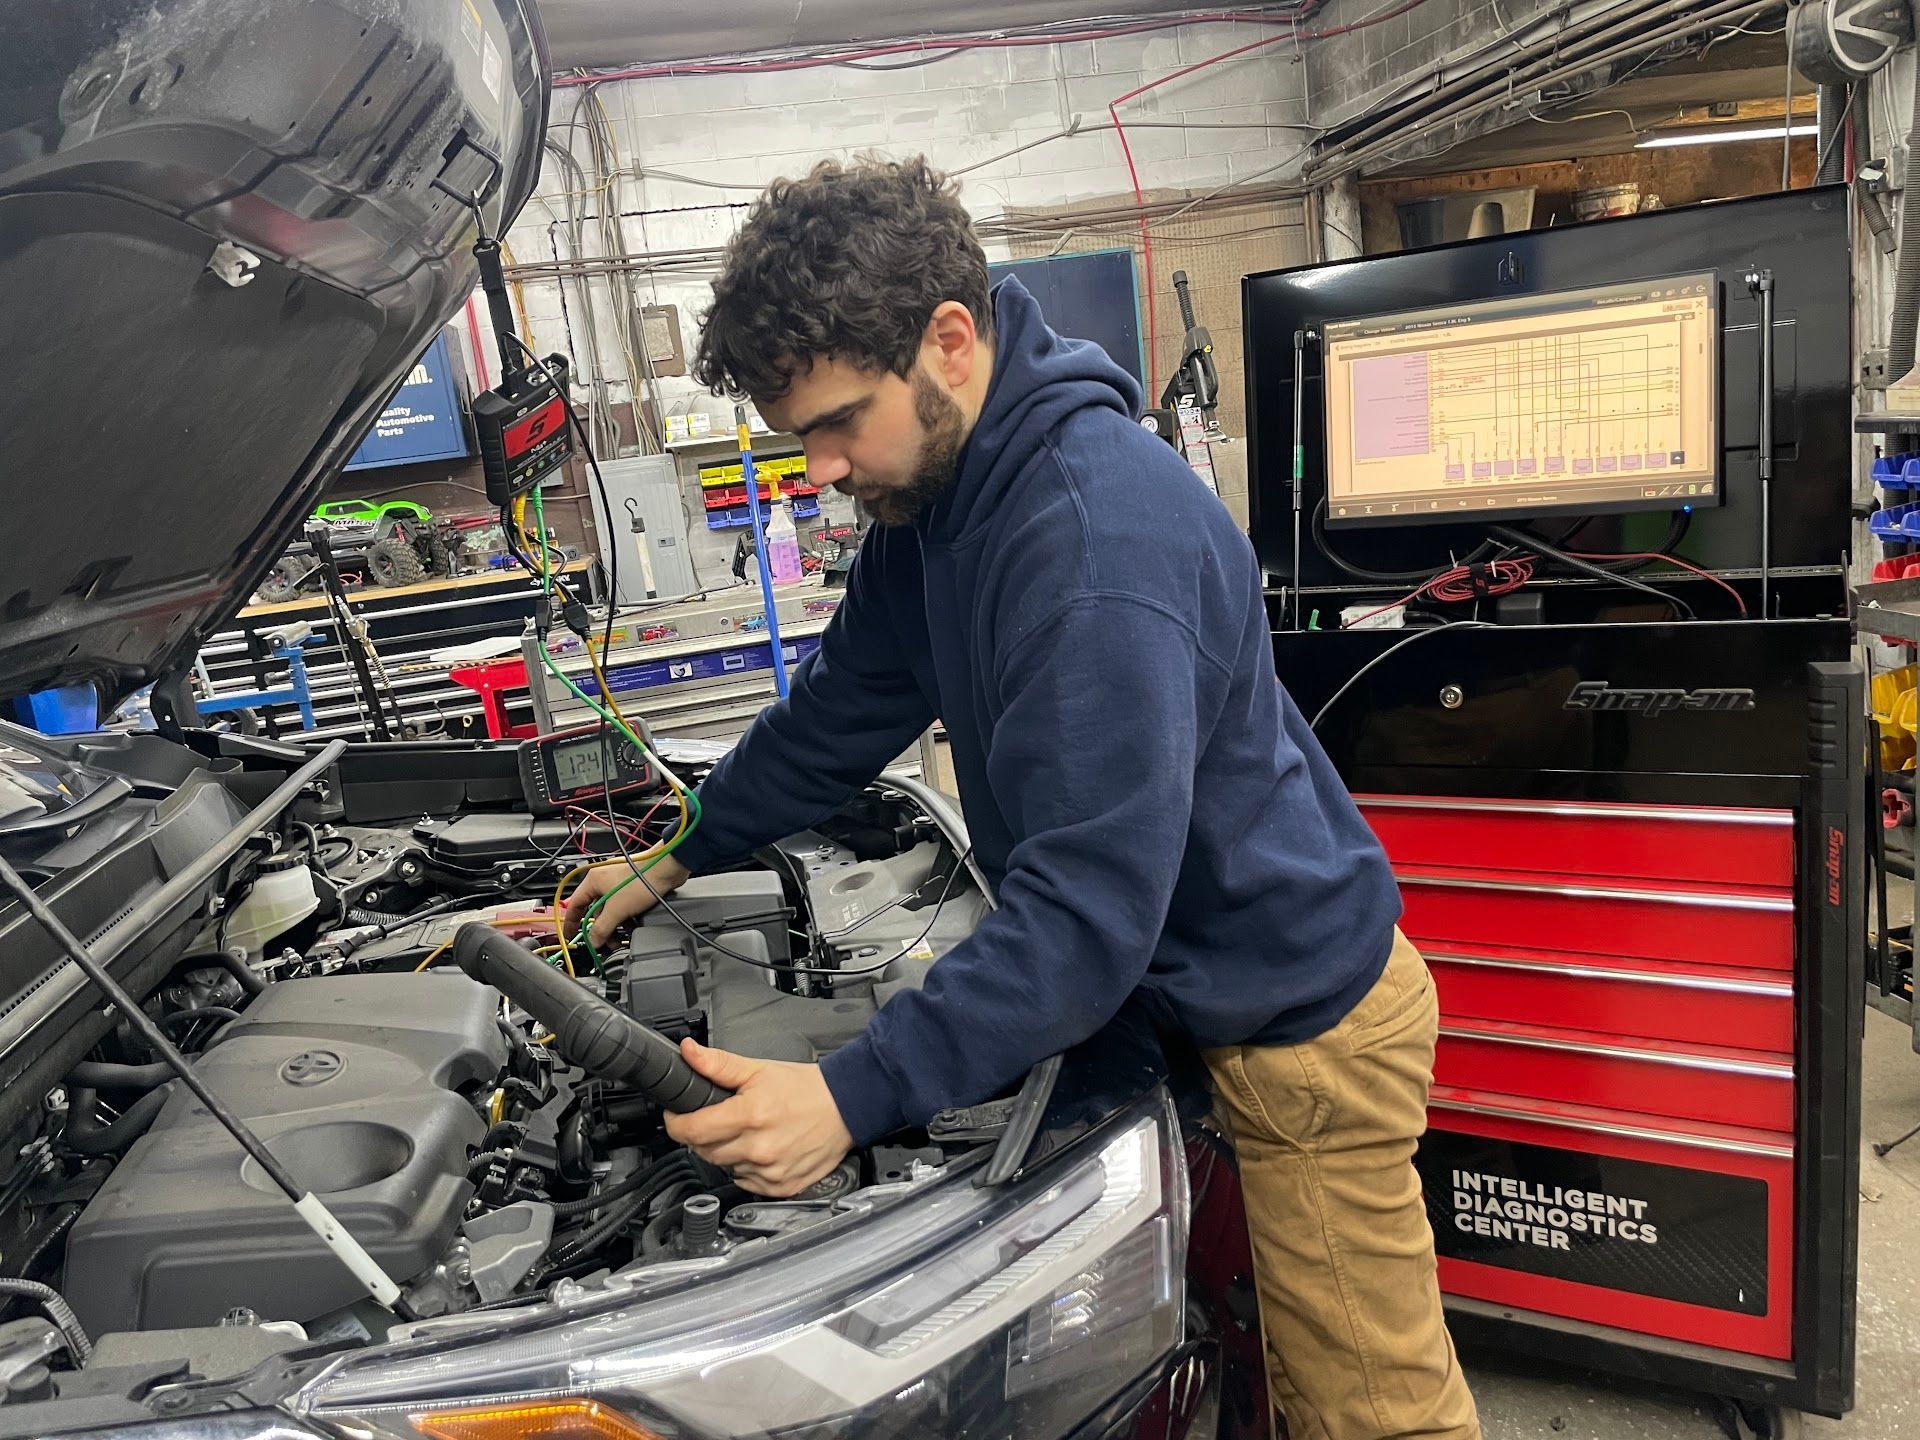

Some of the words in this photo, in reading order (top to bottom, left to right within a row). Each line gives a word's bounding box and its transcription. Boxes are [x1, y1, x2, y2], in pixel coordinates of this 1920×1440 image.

[375, 414, 435, 428] Automotive
[380, 407, 411, 417] uality
[377, 427, 404, 437] Parts
[1561, 680, 1757, 717] Snap-on
[1824, 826, 1845, 907] Snap-on
[1452, 1169, 1648, 1220] INTELLIGENT
[1453, 1190, 1658, 1244] DIAGNOSTICS
[1454, 1212, 1571, 1251] CENTER
